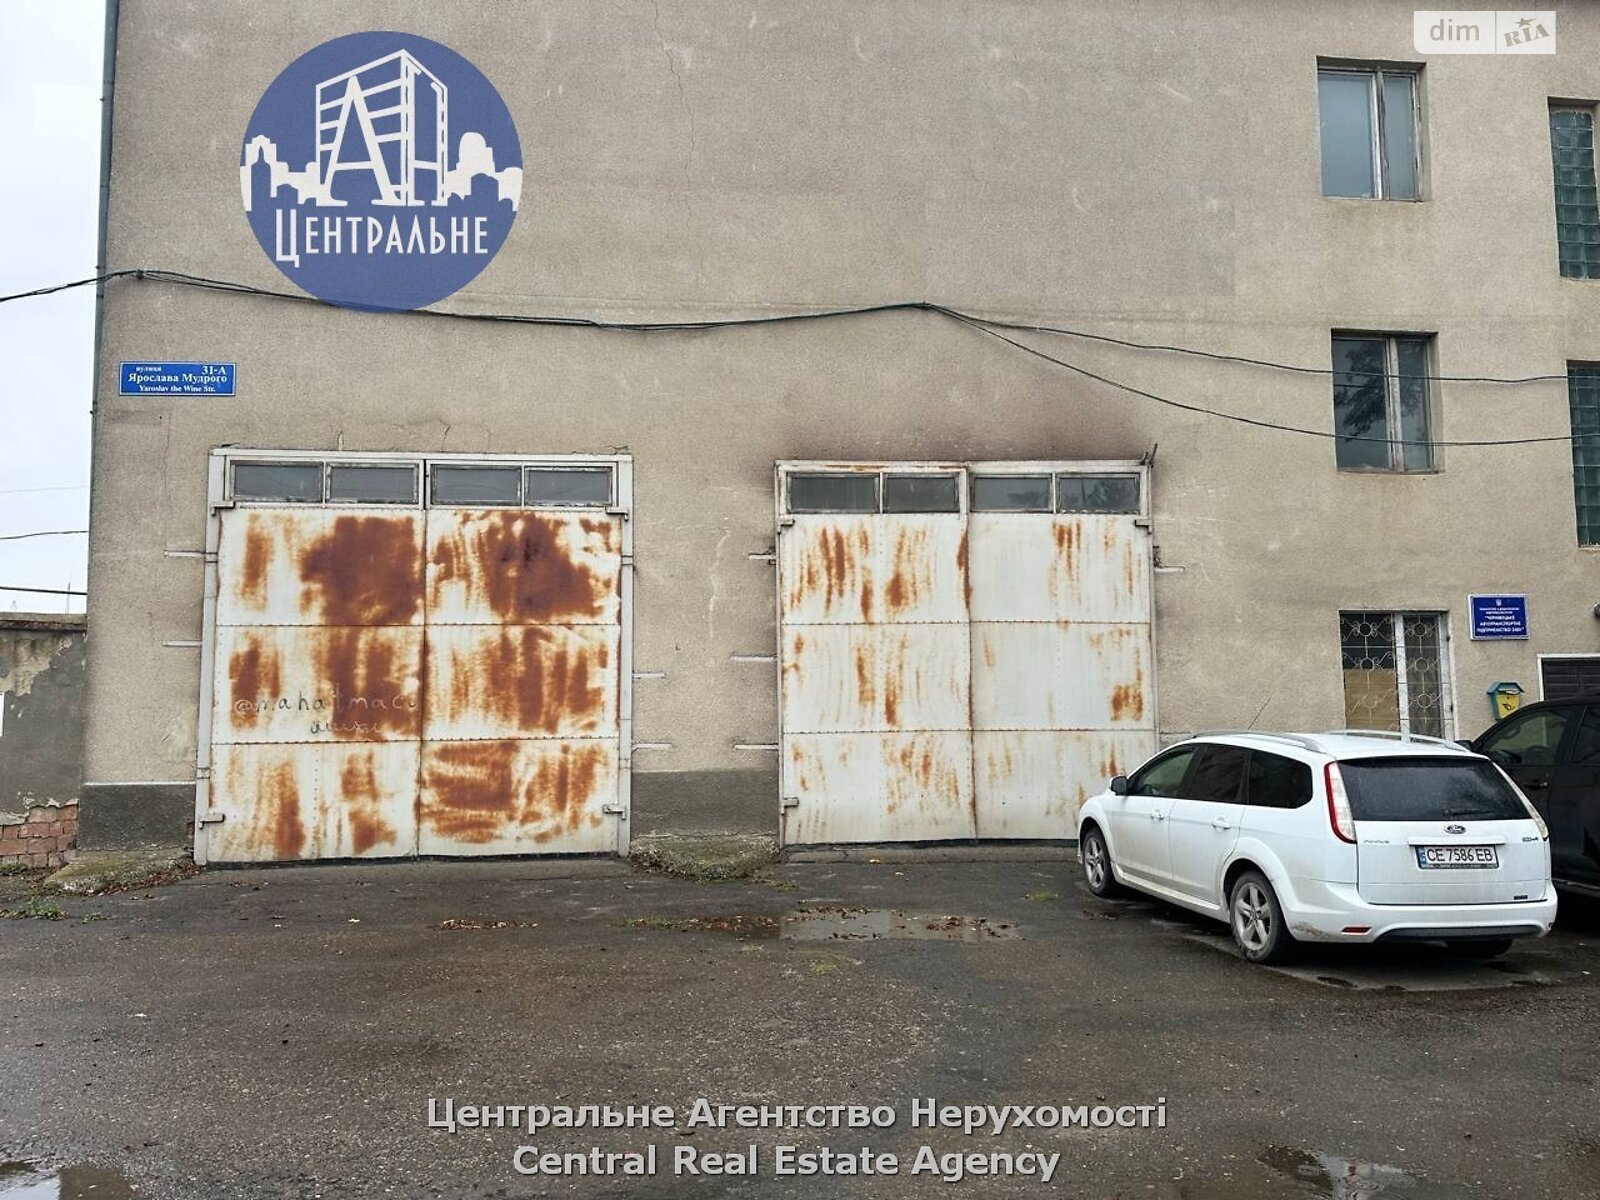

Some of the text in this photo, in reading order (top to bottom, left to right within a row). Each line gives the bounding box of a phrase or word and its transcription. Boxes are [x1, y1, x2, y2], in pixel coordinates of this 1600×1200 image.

[128, 373, 227, 384] Ярослава Мудрого
[1446, 848, 1474, 862] 7586
